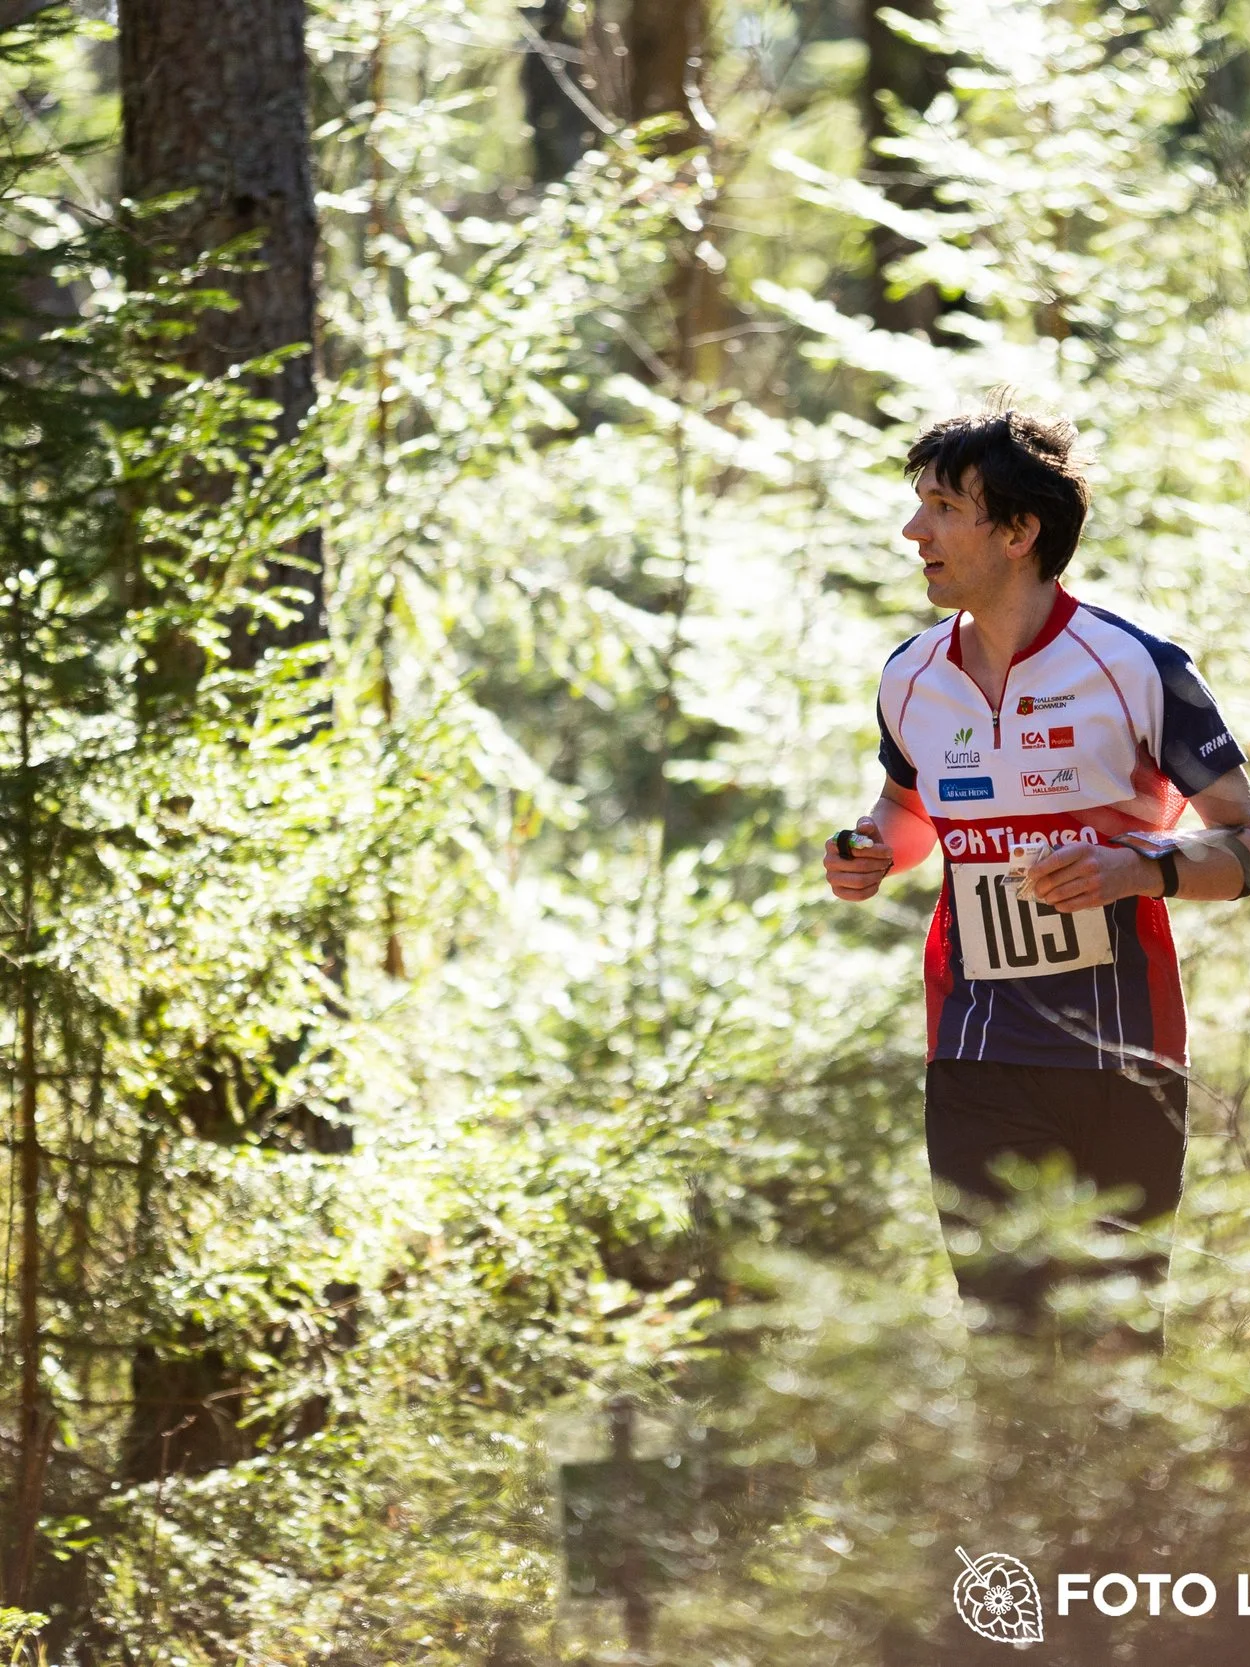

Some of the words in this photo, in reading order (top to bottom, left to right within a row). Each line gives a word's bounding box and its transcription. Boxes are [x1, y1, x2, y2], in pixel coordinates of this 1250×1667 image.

[1034, 694, 1075, 703] HALLSBERGS
[1034, 702, 1067, 710] KOMMUN
[1021, 731, 1046, 745] ICA
[944, 750, 981, 764] Kumla
[1023, 773, 1047, 787] ICA
[1032, 785, 1070, 793] HALLSBERG
[975, 874, 1080, 970] 105
